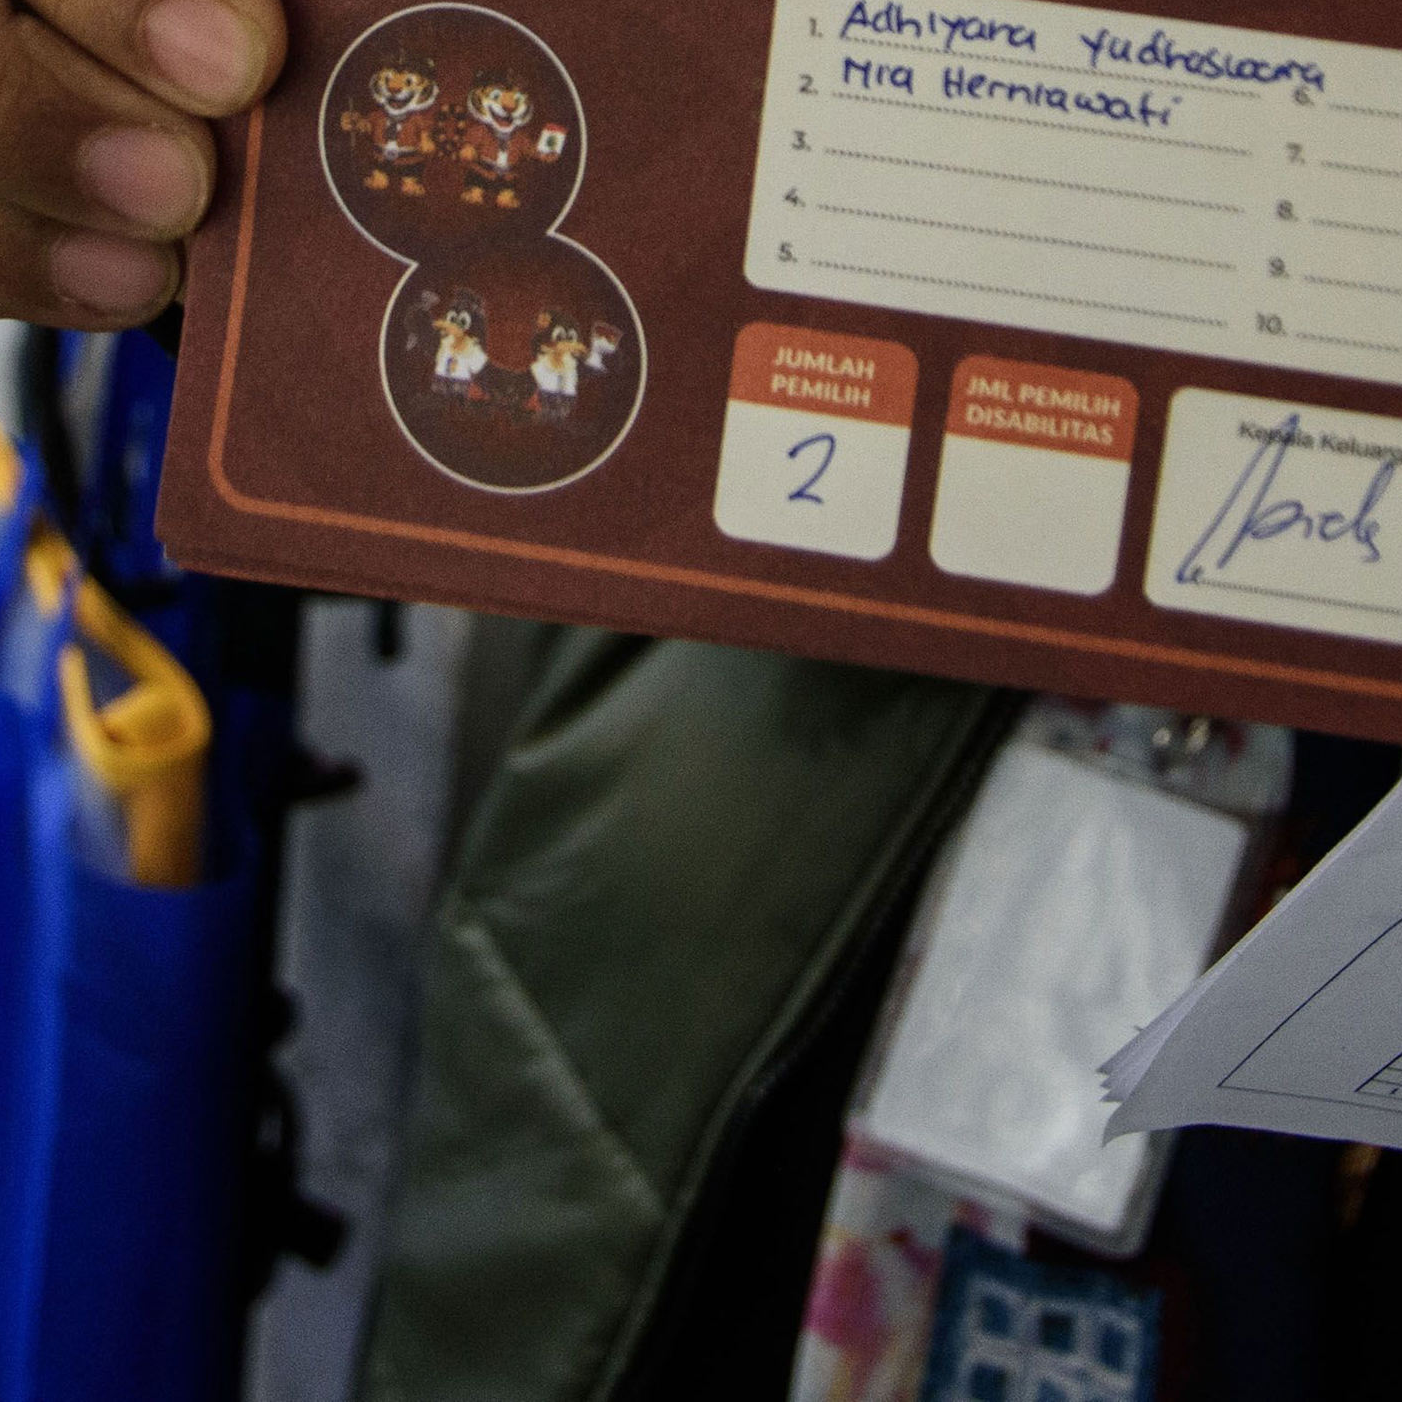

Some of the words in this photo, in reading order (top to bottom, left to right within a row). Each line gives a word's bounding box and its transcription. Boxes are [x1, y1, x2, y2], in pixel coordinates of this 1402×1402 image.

[798, 73, 819, 96] 2.
[791, 130, 812, 153] 3.
[1285, 142, 1306, 166] 7.
[784, 188, 807, 209] 4.
[1276, 200, 1299, 223] 8.
[777, 243, 799, 265] 5.
[1268, 257, 1290, 280] 9.
[1256, 314, 1287, 339] 10.
[772, 346, 876, 380] JUMLAH
[771, 373, 873, 409] PEMILIH
[964, 375, 1016, 402] JML
[1019, 383, 1122, 420] PEMILIH
[964, 403, 1115, 447] DISABILITAS
[786, 431, 838, 506] 2
